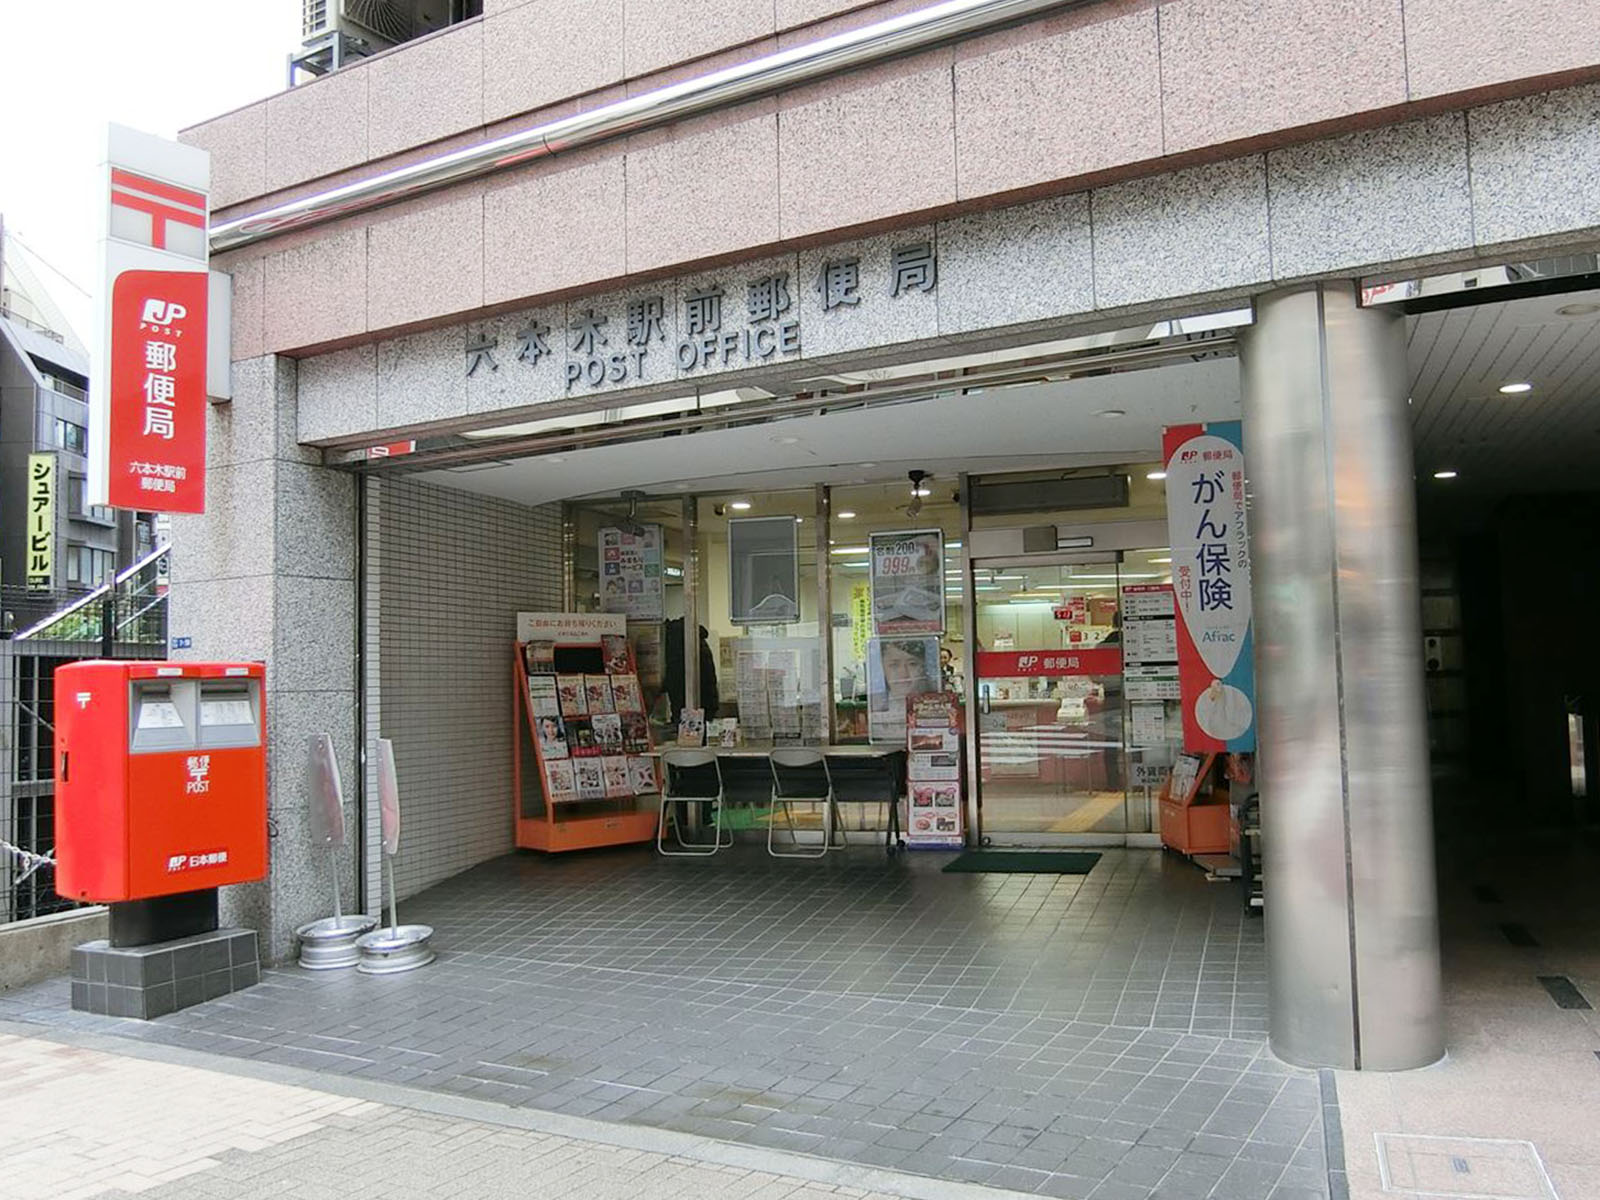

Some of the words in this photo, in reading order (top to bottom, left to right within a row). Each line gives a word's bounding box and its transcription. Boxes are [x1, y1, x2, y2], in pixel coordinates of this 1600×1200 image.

[466, 242, 938, 377] 六本木駅前郵便局
[139, 322, 184, 338] POST
[565, 346, 648, 389] POST
[675, 320, 801, 371] OFFICE
[143, 340, 177, 440] 郵便局
[129, 461, 187, 480] 六本木駅前
[141, 478, 176, 493] 郵便局
[32, 463, 51, 572] シュアービル
[1191, 470, 1234, 612] がん保険
[1043, 657, 1080, 669] 郵便局
[187, 755, 210, 769] 郵便
[186, 781, 210, 793] POST
[189, 851, 228, 868] 日本郵便
